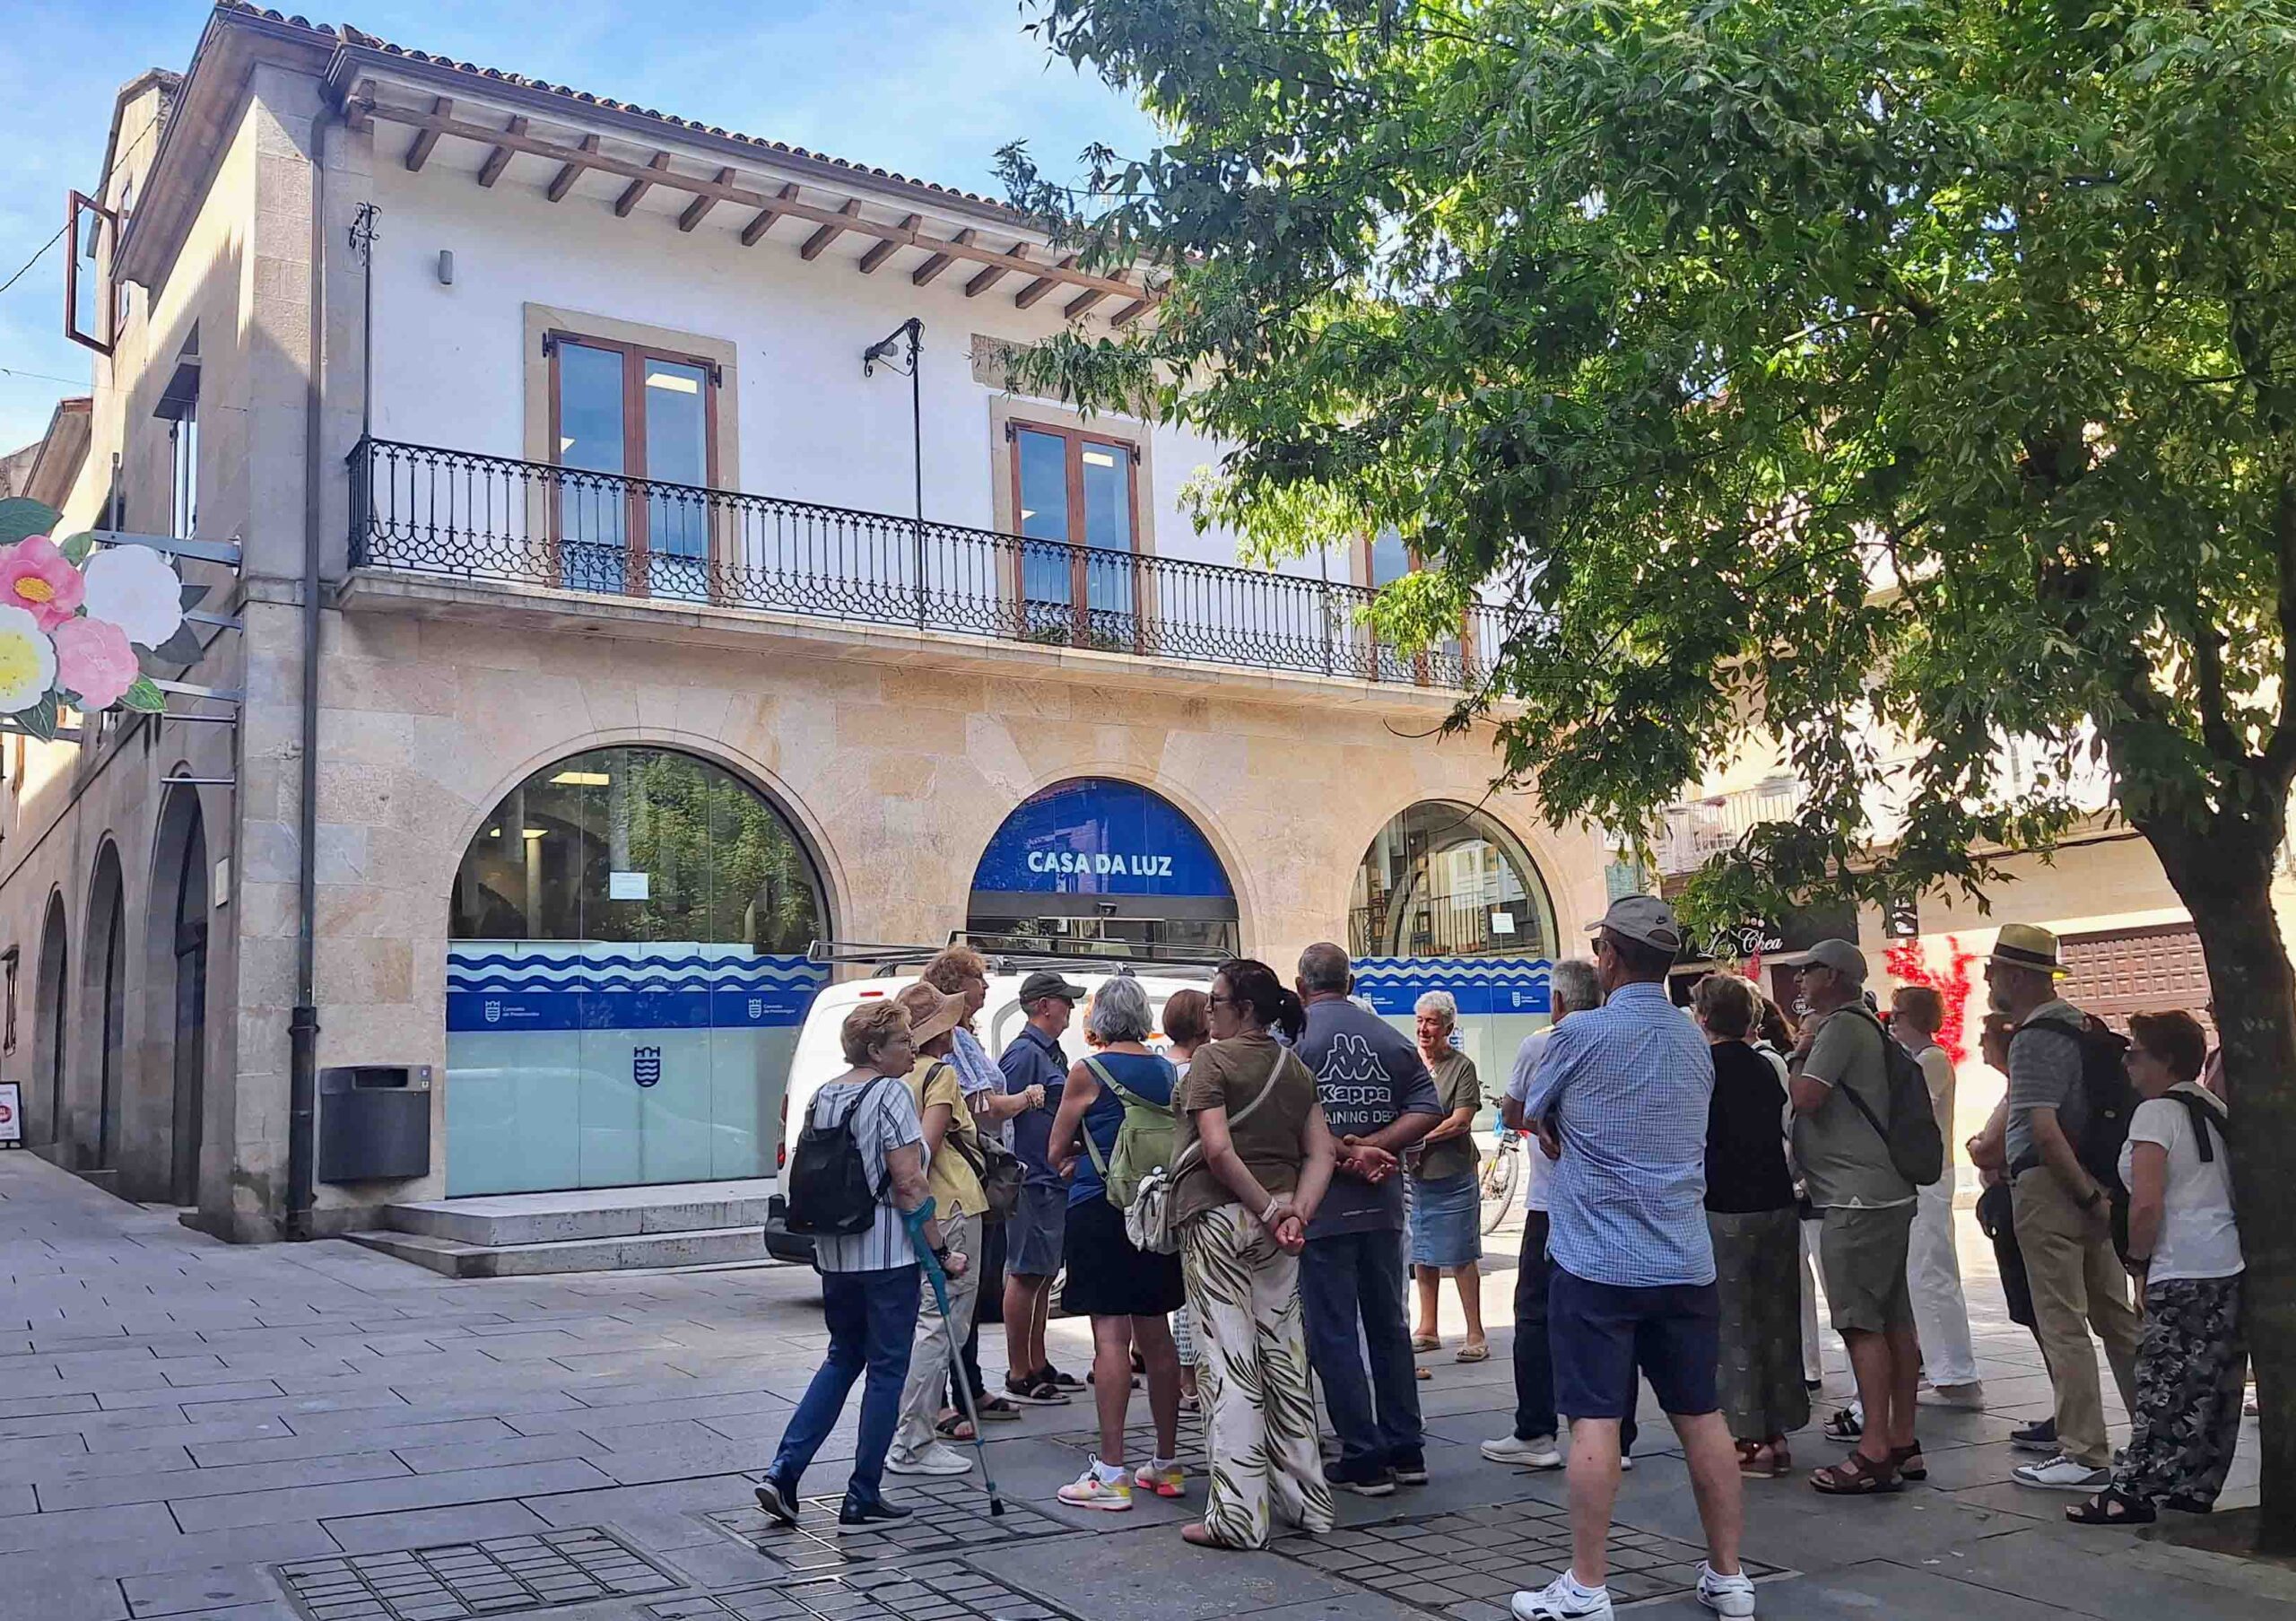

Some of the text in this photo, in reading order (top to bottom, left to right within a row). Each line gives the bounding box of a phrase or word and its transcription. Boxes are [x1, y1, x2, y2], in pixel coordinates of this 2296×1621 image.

[1027, 851, 1172, 876] CASA DA LUZ
[1317, 1084, 1391, 1104] Kappa
[1325, 1111, 1369, 1125] AINING
